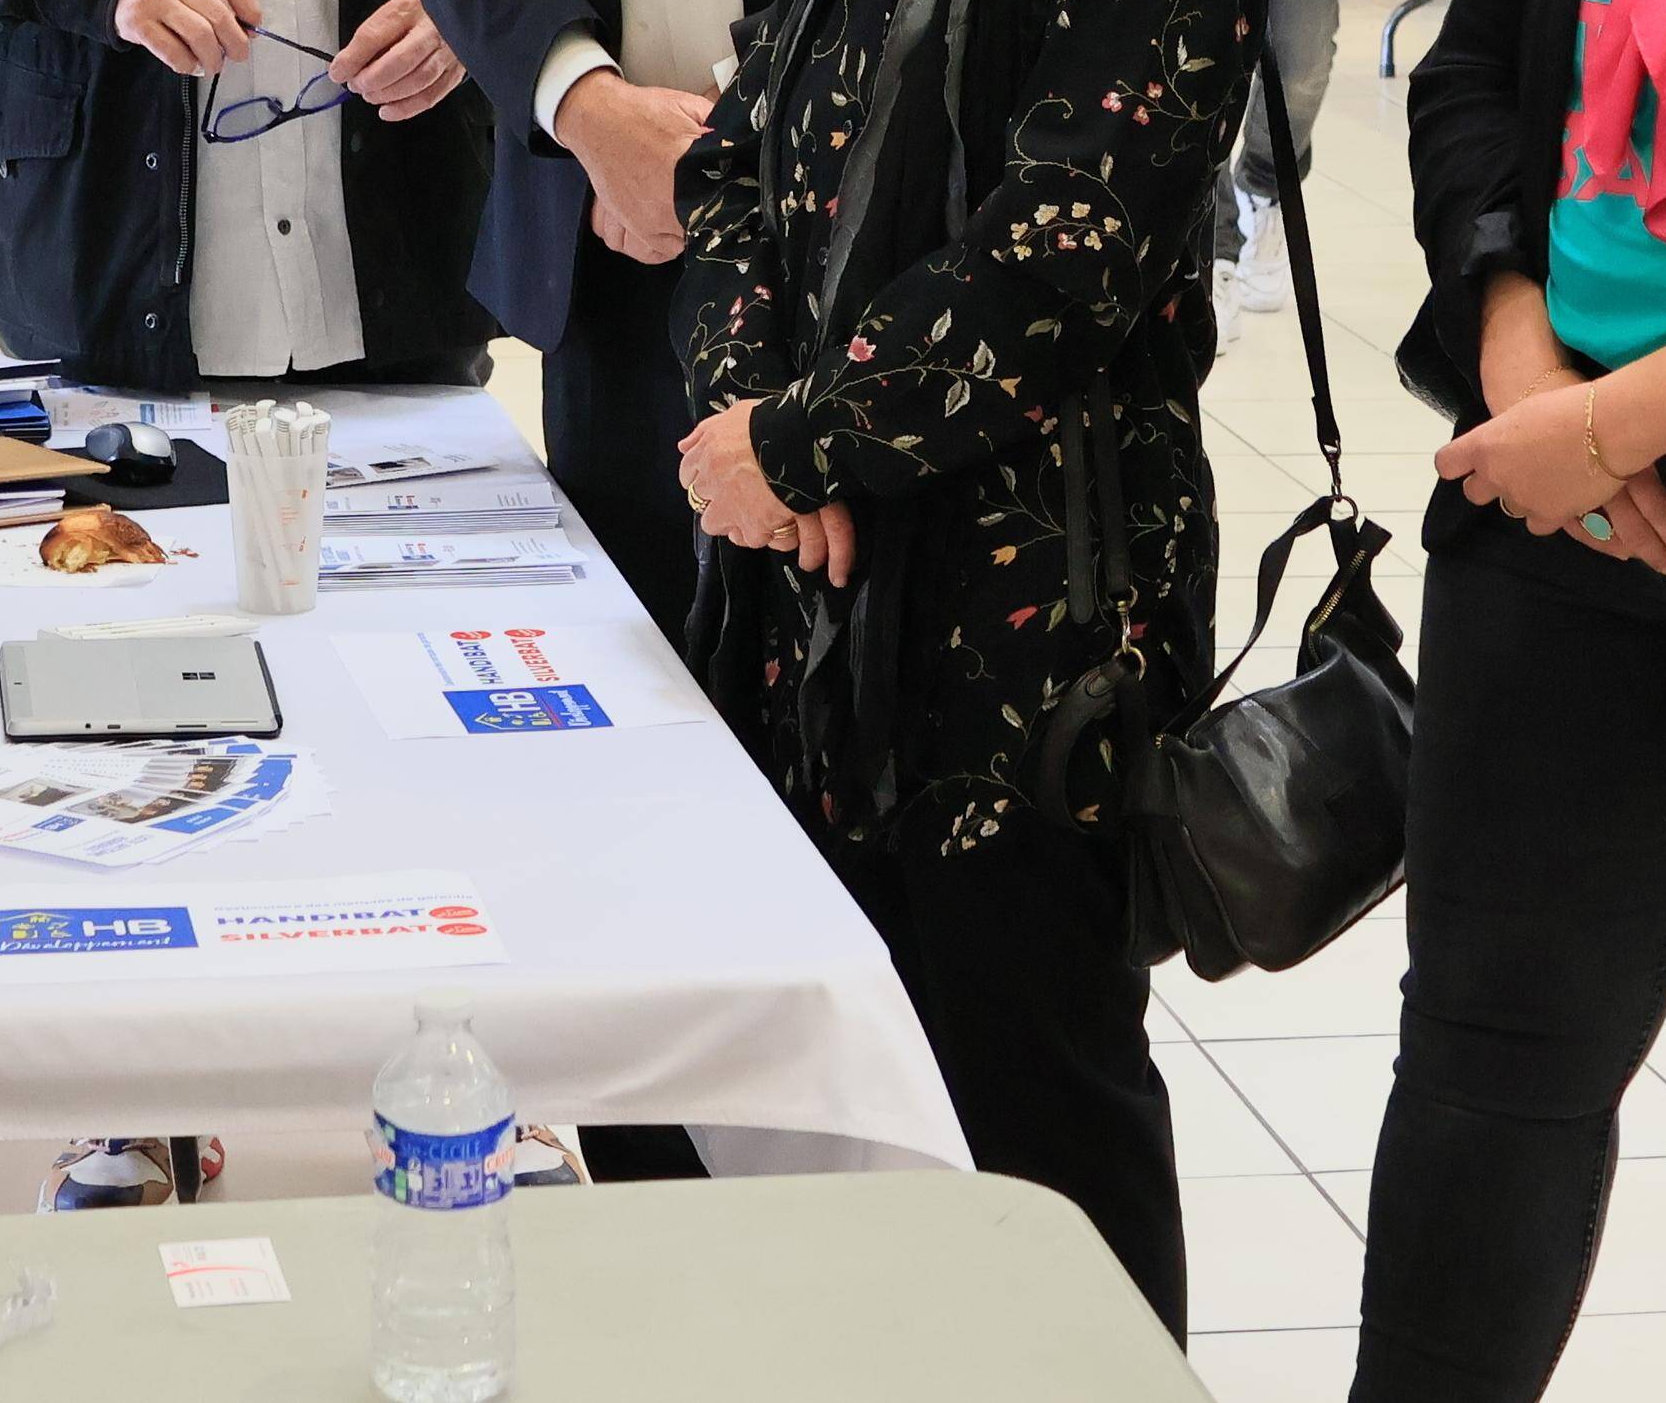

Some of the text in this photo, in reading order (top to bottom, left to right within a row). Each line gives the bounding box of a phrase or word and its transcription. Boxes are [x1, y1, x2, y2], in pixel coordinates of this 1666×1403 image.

[457, 640, 503, 685] HANDIBAT
[511, 639, 561, 683] SILVERBAT
[488, 691, 541, 713] HB
[217, 908, 425, 925] HANDIBAT
[81, 919, 172, 938] HB
[220, 924, 432, 942] SILVERBAT
